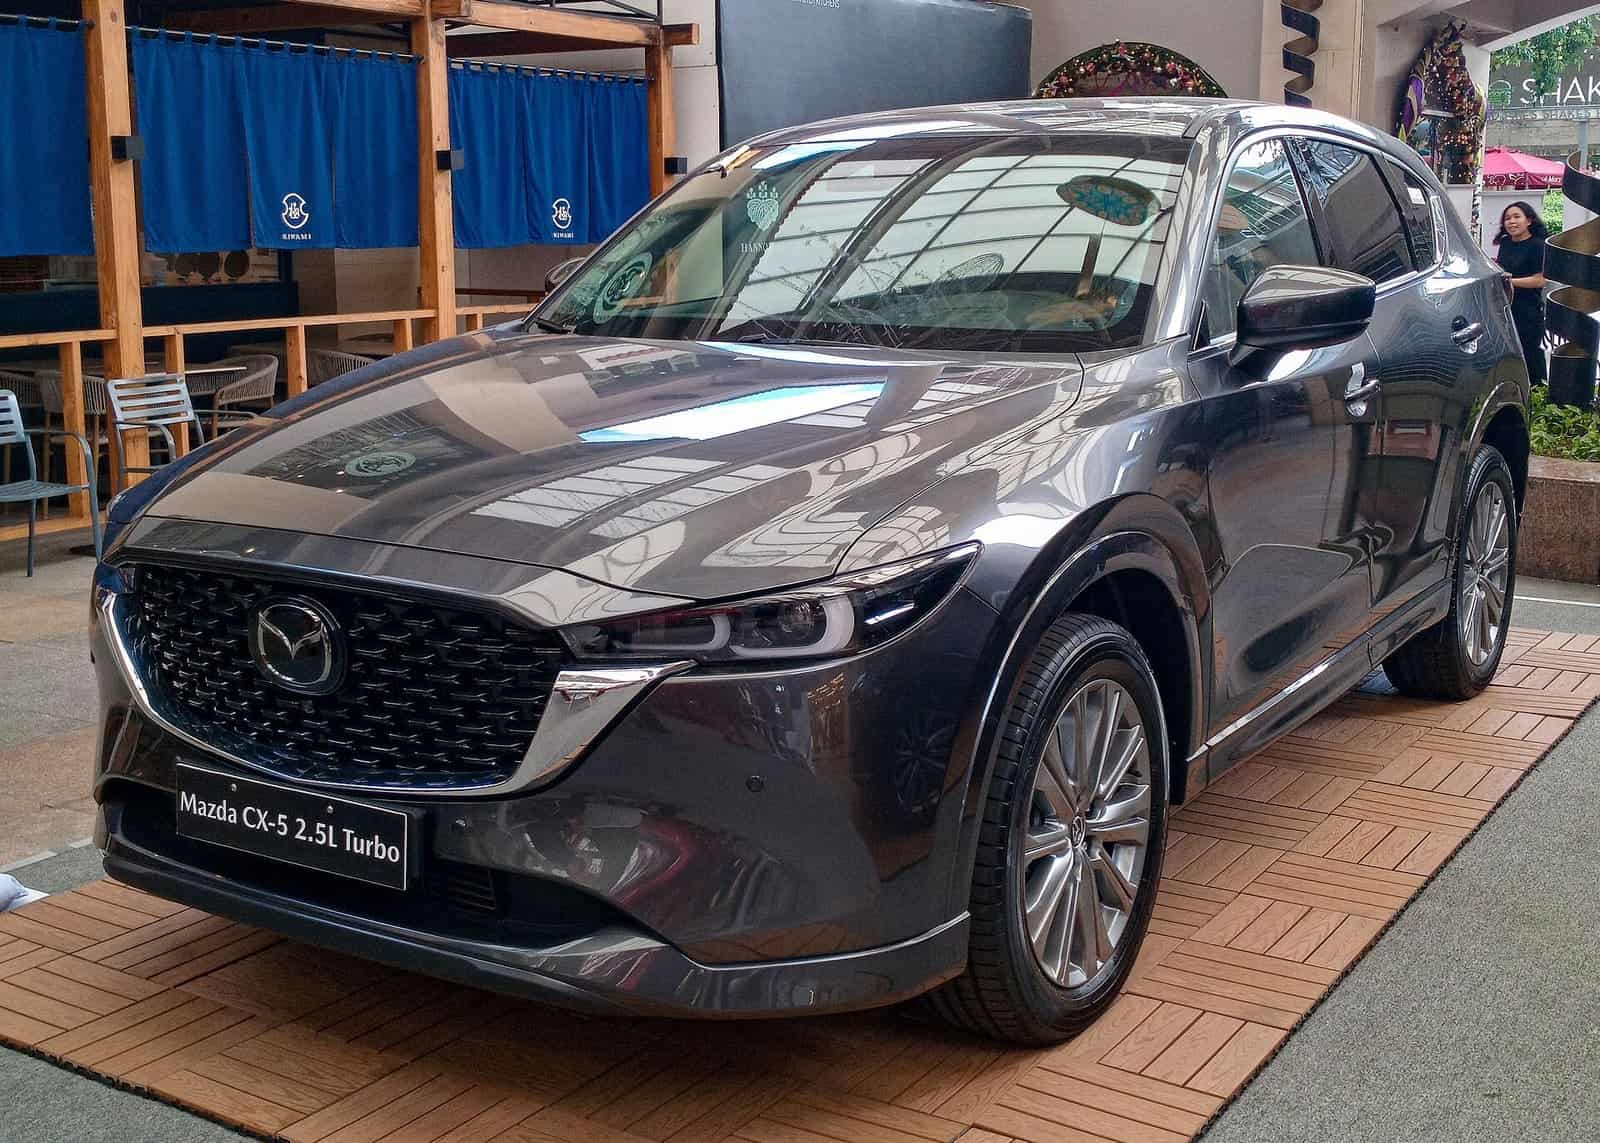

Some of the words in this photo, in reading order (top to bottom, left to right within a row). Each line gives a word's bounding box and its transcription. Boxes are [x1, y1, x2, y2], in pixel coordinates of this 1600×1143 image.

[180, 791, 237, 825] Mazda
[242, 806, 288, 836] CX-5
[294, 818, 338, 848] 2.5L
[342, 828, 400, 863] Turbo
